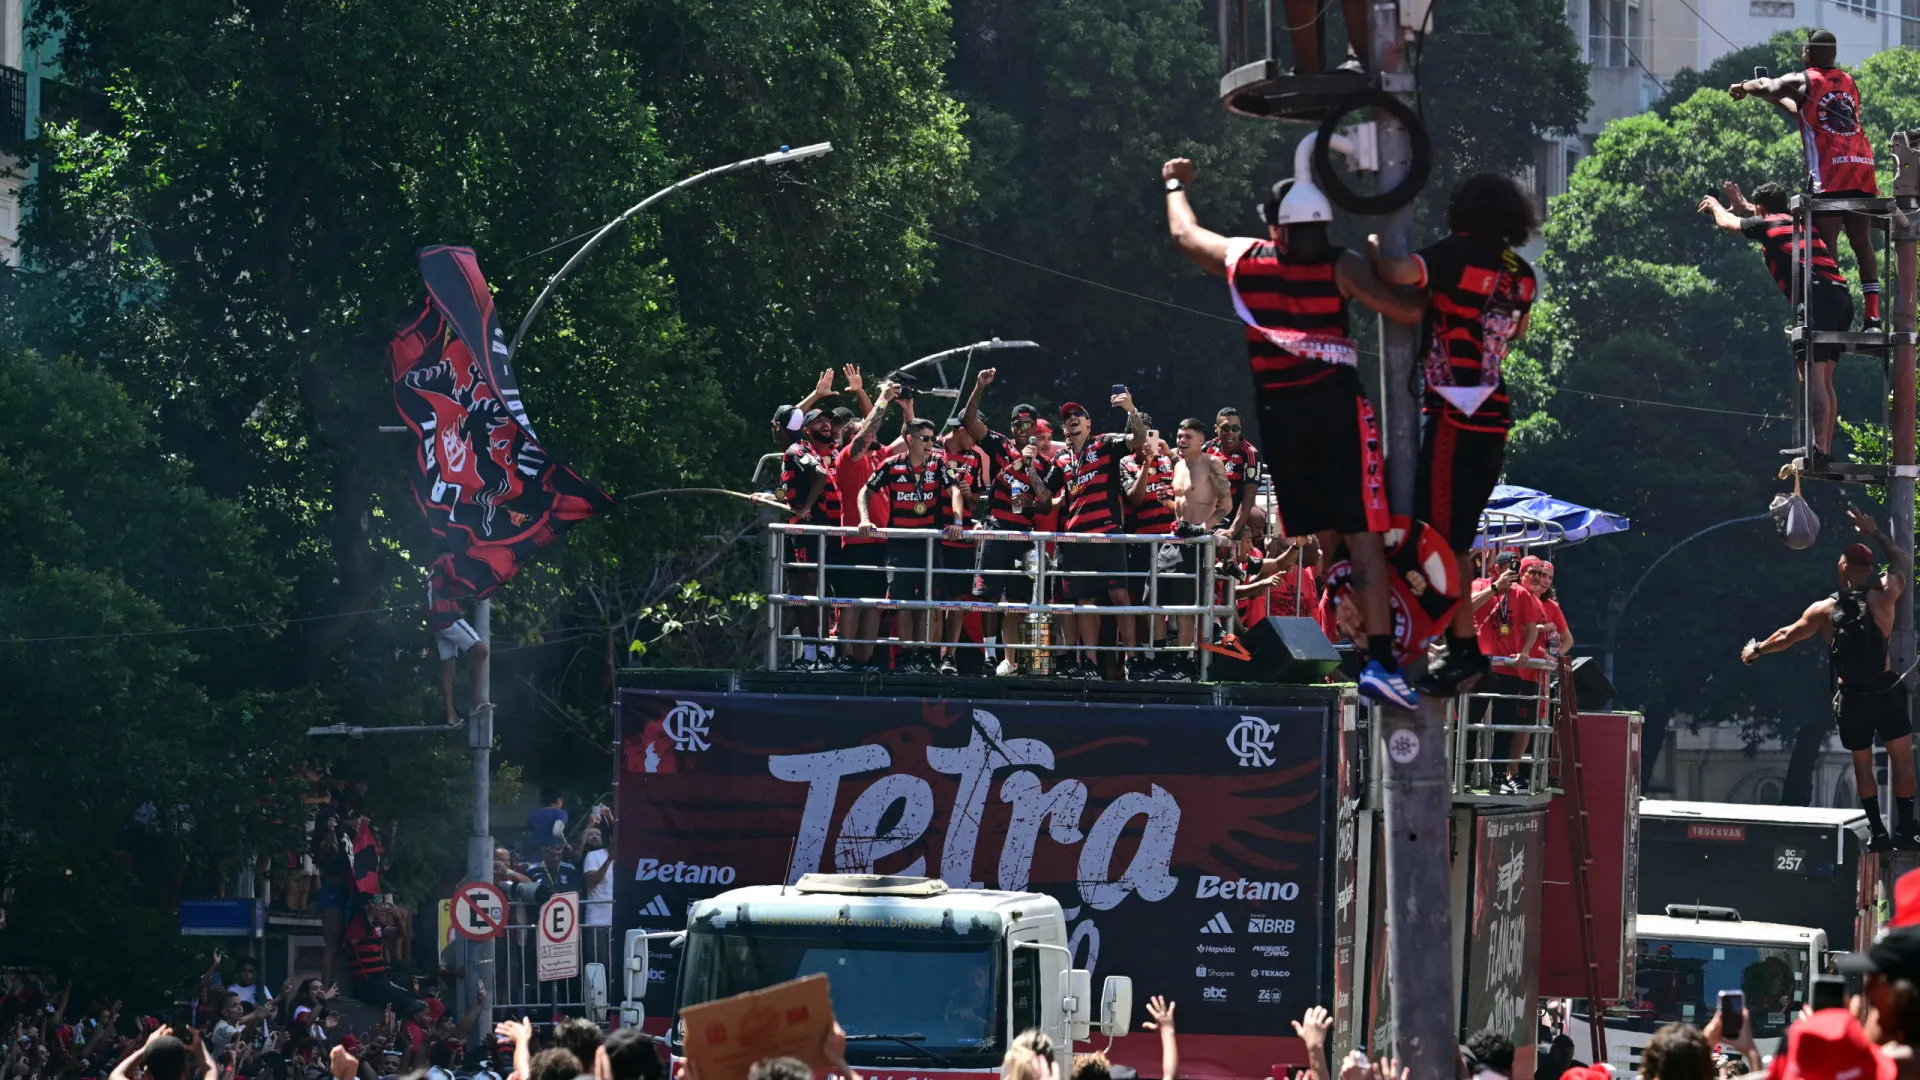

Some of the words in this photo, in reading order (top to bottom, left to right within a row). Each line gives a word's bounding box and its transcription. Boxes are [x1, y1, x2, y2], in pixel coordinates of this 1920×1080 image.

[768, 708, 1182, 911] Tetra
[1692, 826, 1741, 837] TRUCKVAN
[1784, 849, 1796, 857] SC
[1777, 856, 1803, 871] 257
[635, 858, 736, 885] Betano
[1195, 875, 1300, 901] Betano
[553, 907, 565, 933] E
[1263, 919, 1296, 934] BRB
[1205, 945, 1236, 954] Hapvida
[1207, 968, 1235, 979] Shopee
[1203, 986, 1227, 999] abc
